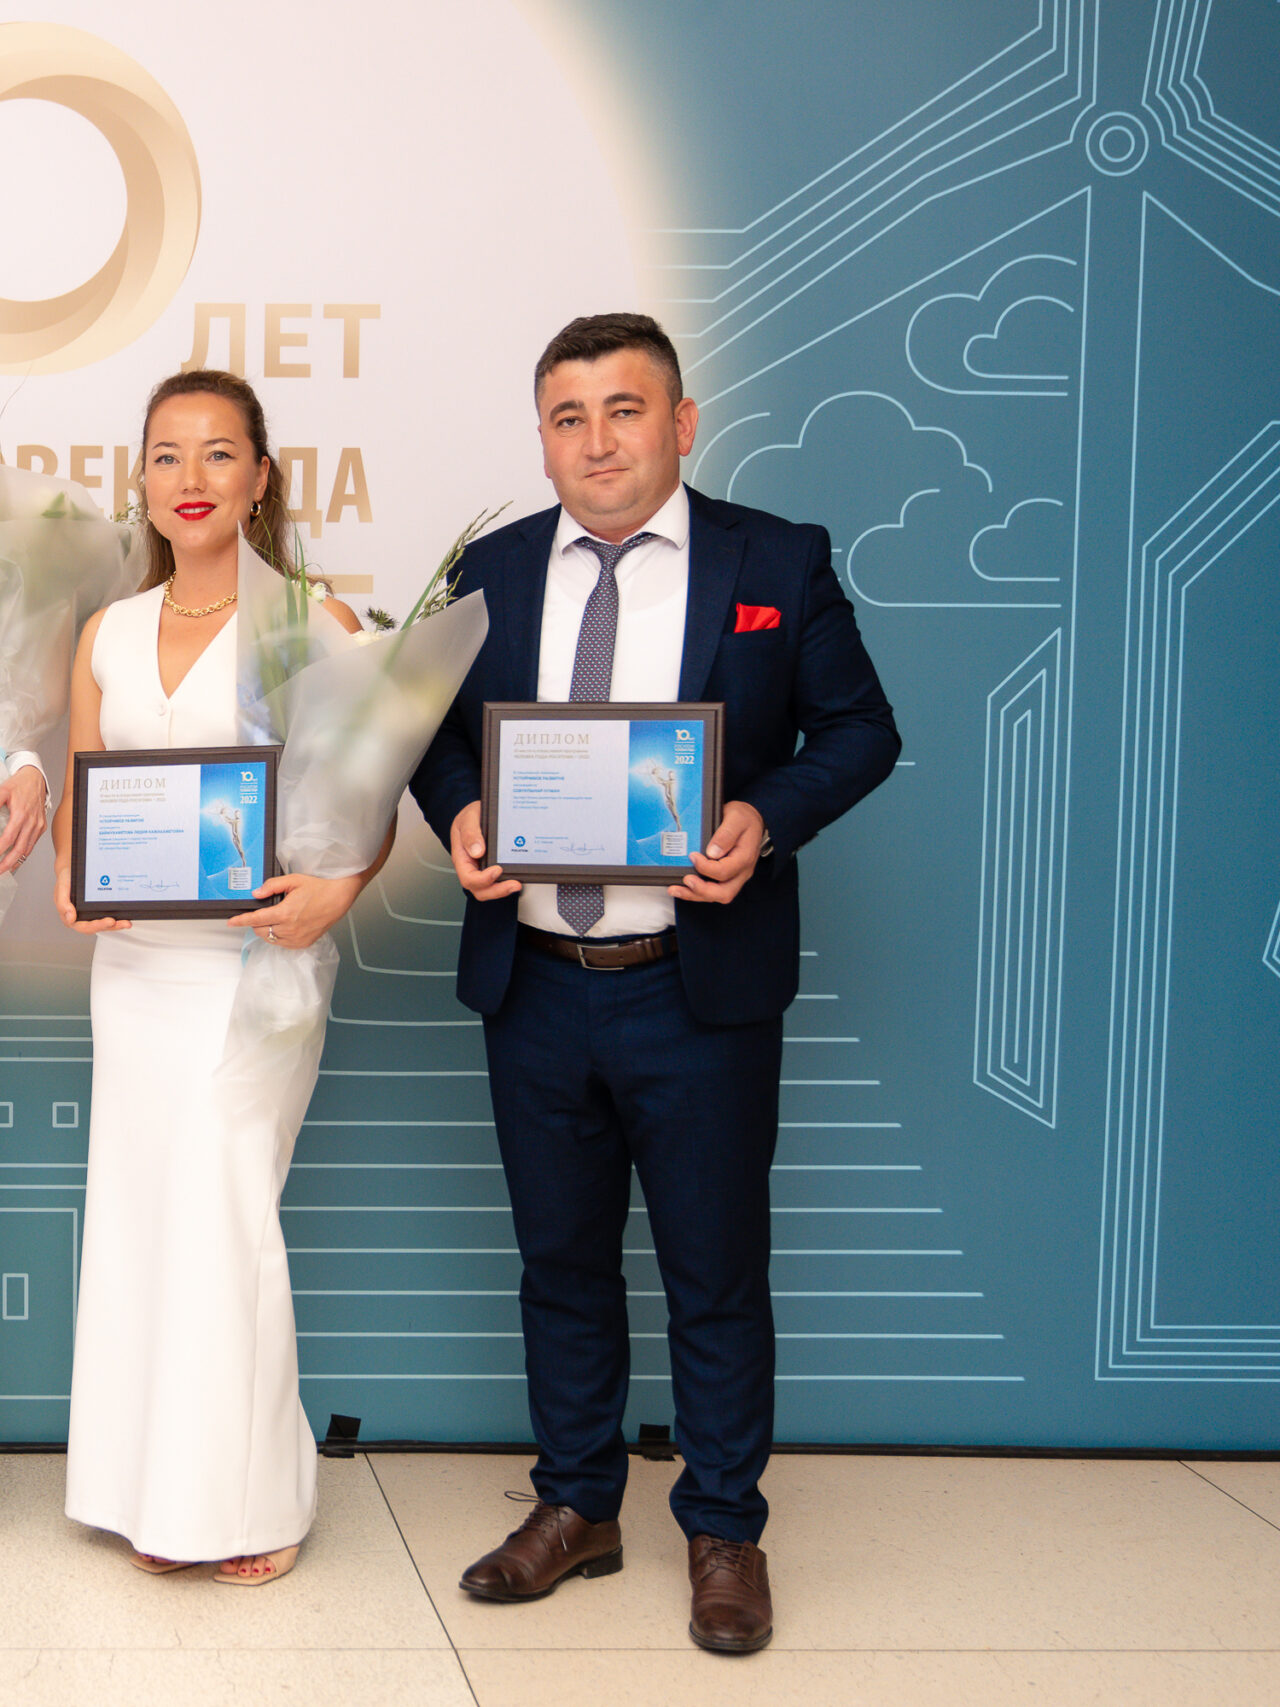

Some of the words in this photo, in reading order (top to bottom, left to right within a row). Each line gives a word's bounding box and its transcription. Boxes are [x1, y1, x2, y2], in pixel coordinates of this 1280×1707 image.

[181, 303, 381, 378] ЛЕТ
[513, 733, 590, 746] ДИПЛОМ
[674, 756, 695, 765] 2022
[99, 777, 166, 792] ДИПЛОМ
[240, 796, 257, 804] 2022
